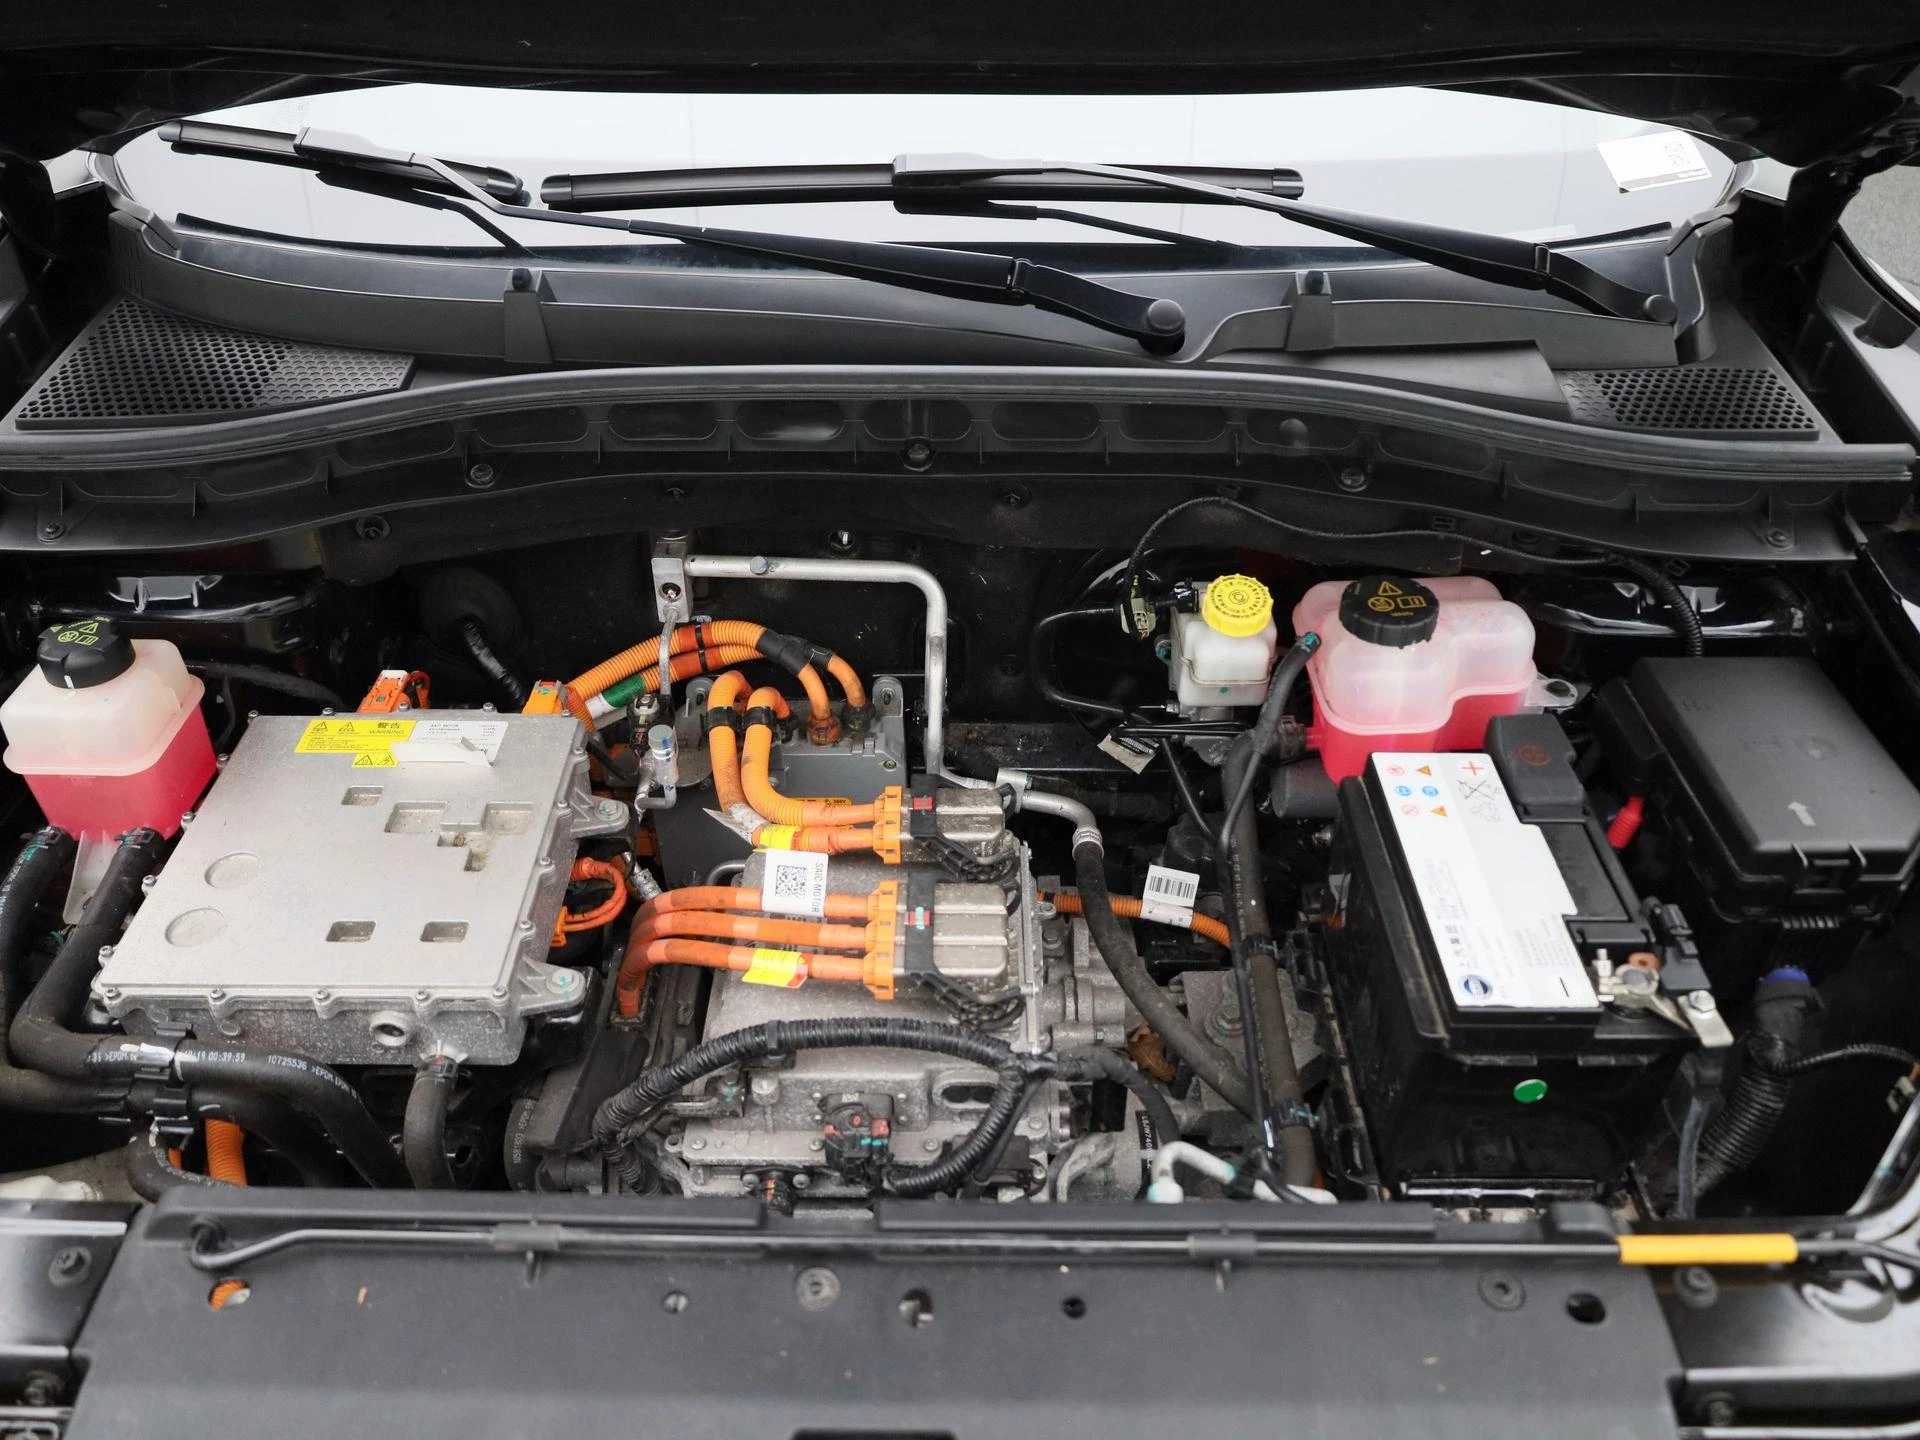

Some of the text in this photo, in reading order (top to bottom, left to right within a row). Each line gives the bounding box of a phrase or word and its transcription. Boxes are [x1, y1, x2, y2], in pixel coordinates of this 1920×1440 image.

[814, 862, 824, 881] SAIC
[811, 884, 822, 913] MOTOR
[208, 1050, 246, 1063] 00:39:59
[267, 1054, 308, 1071] 10725536
